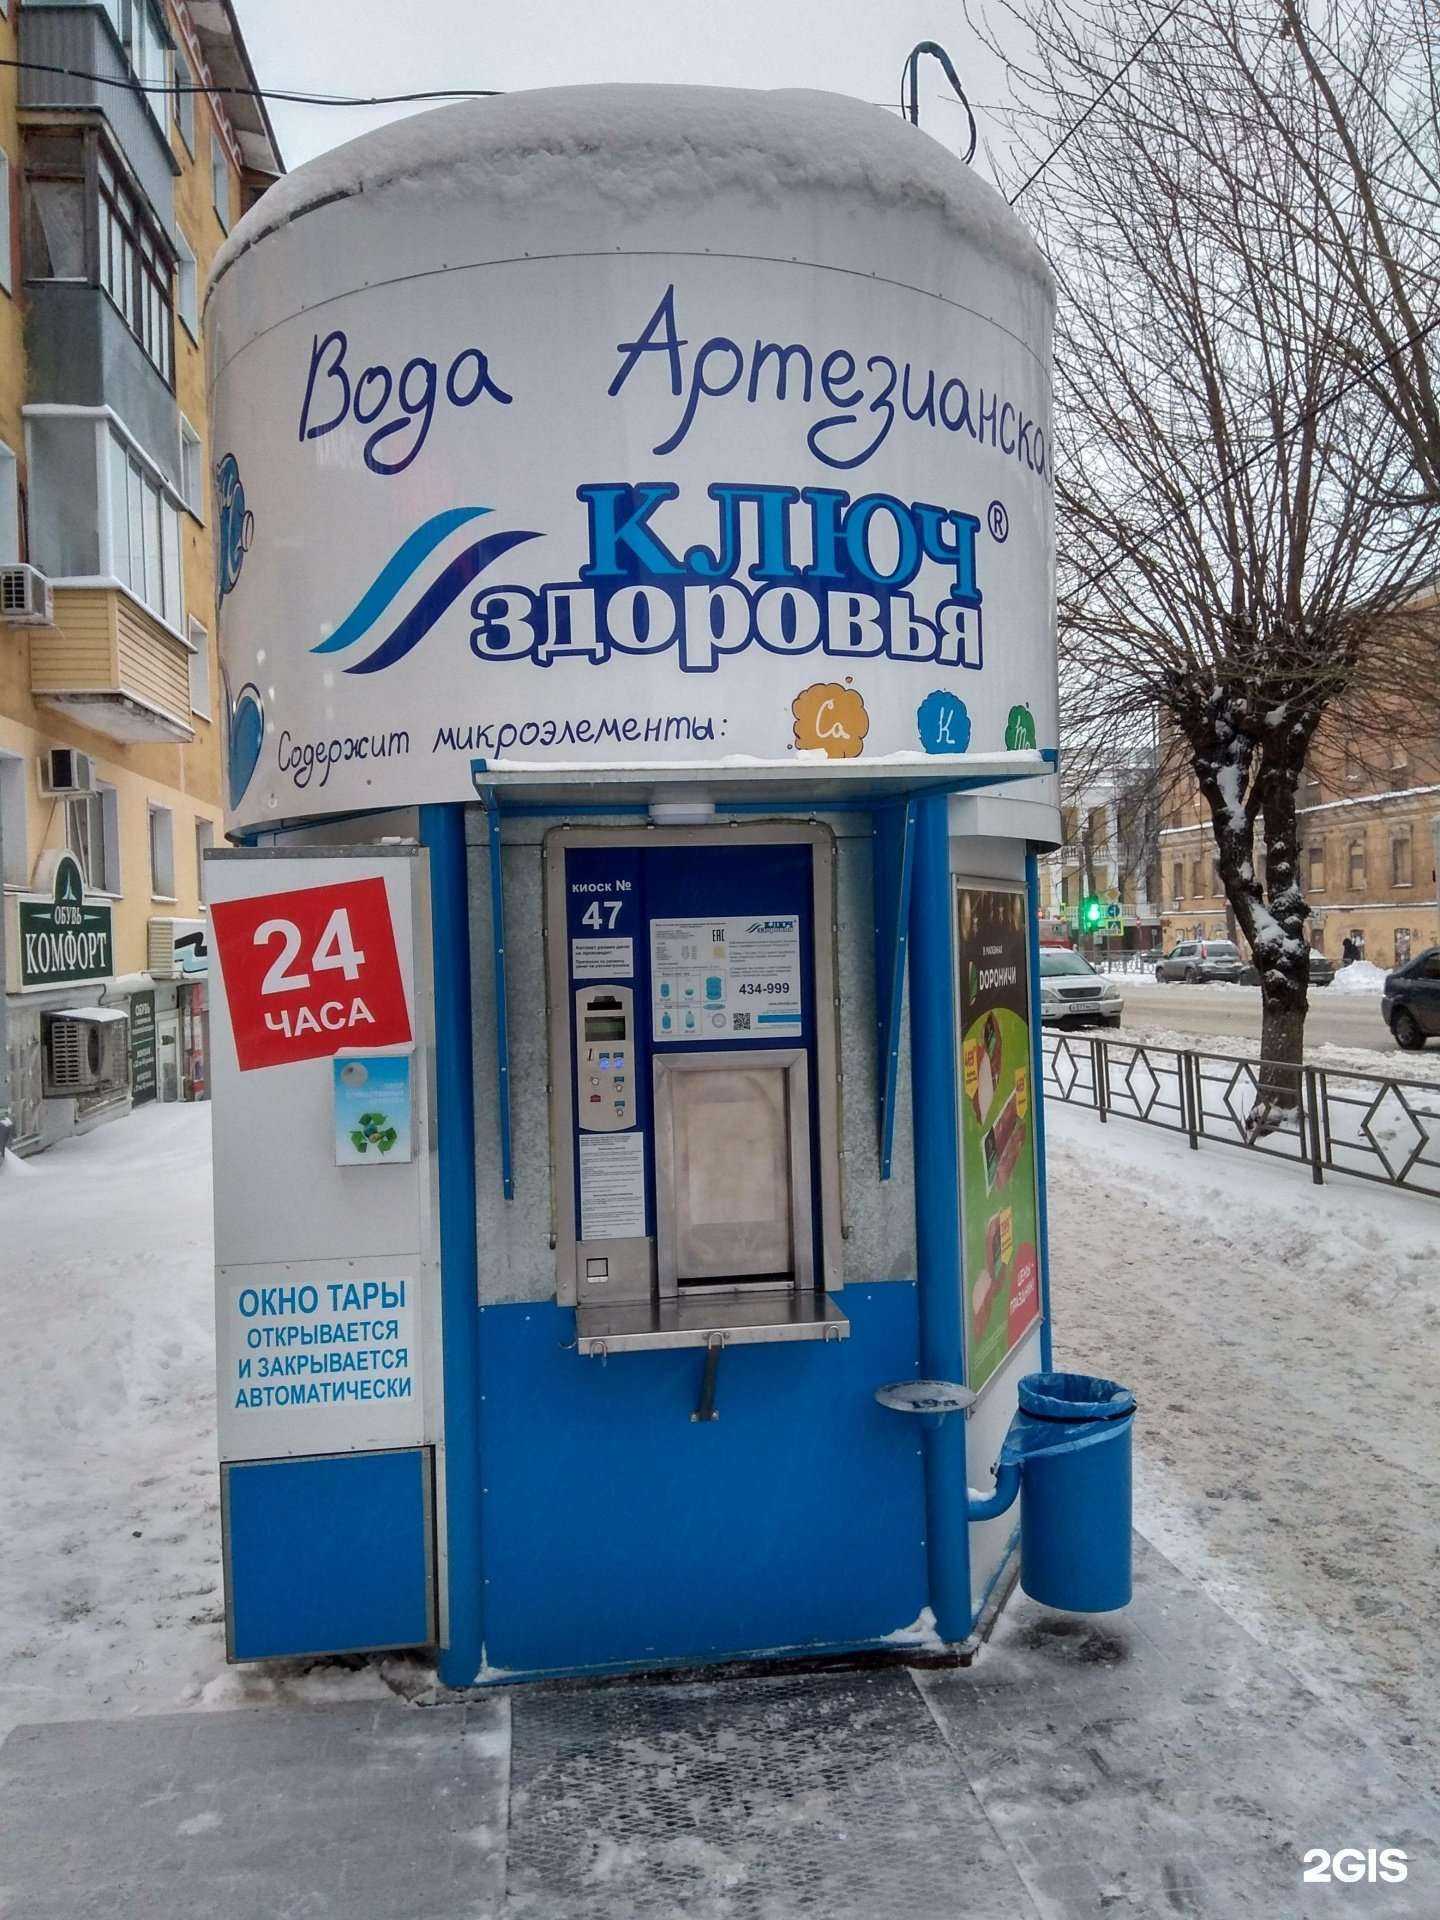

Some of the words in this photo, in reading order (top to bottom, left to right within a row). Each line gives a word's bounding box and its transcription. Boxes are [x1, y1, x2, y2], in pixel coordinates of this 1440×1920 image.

[299, 331, 513, 475] Вода
[608, 284, 1052, 488] Артезианска
[577, 482, 981, 600] КЛЮЧ
[470, 581, 983, 673] здоровья
[278, 730, 410, 789] Содержит
[432, 716, 729, 760] микроэлементы:
[54, 906, 82, 925] ОБУВЬ
[582, 901, 622, 930] 47
[25, 930, 106, 974] КОМФОРТ
[253, 908, 366, 995] 24
[739, 982, 790, 995] 434-999
[264, 997, 375, 1038] ЧАСА
[238, 1286, 319, 1317] ОКНО
[326, 1280, 405, 1312] ТАРЫ
[247, 1320, 398, 1349] ОТКРЫВАЕТСЯ
[238, 1359, 251, 1379] И
[257, 1348, 408, 1378] ЗАКРЫВАЕТСЯ
[235, 1377, 411, 1408] АВТОМАТИЧЕСКИ
